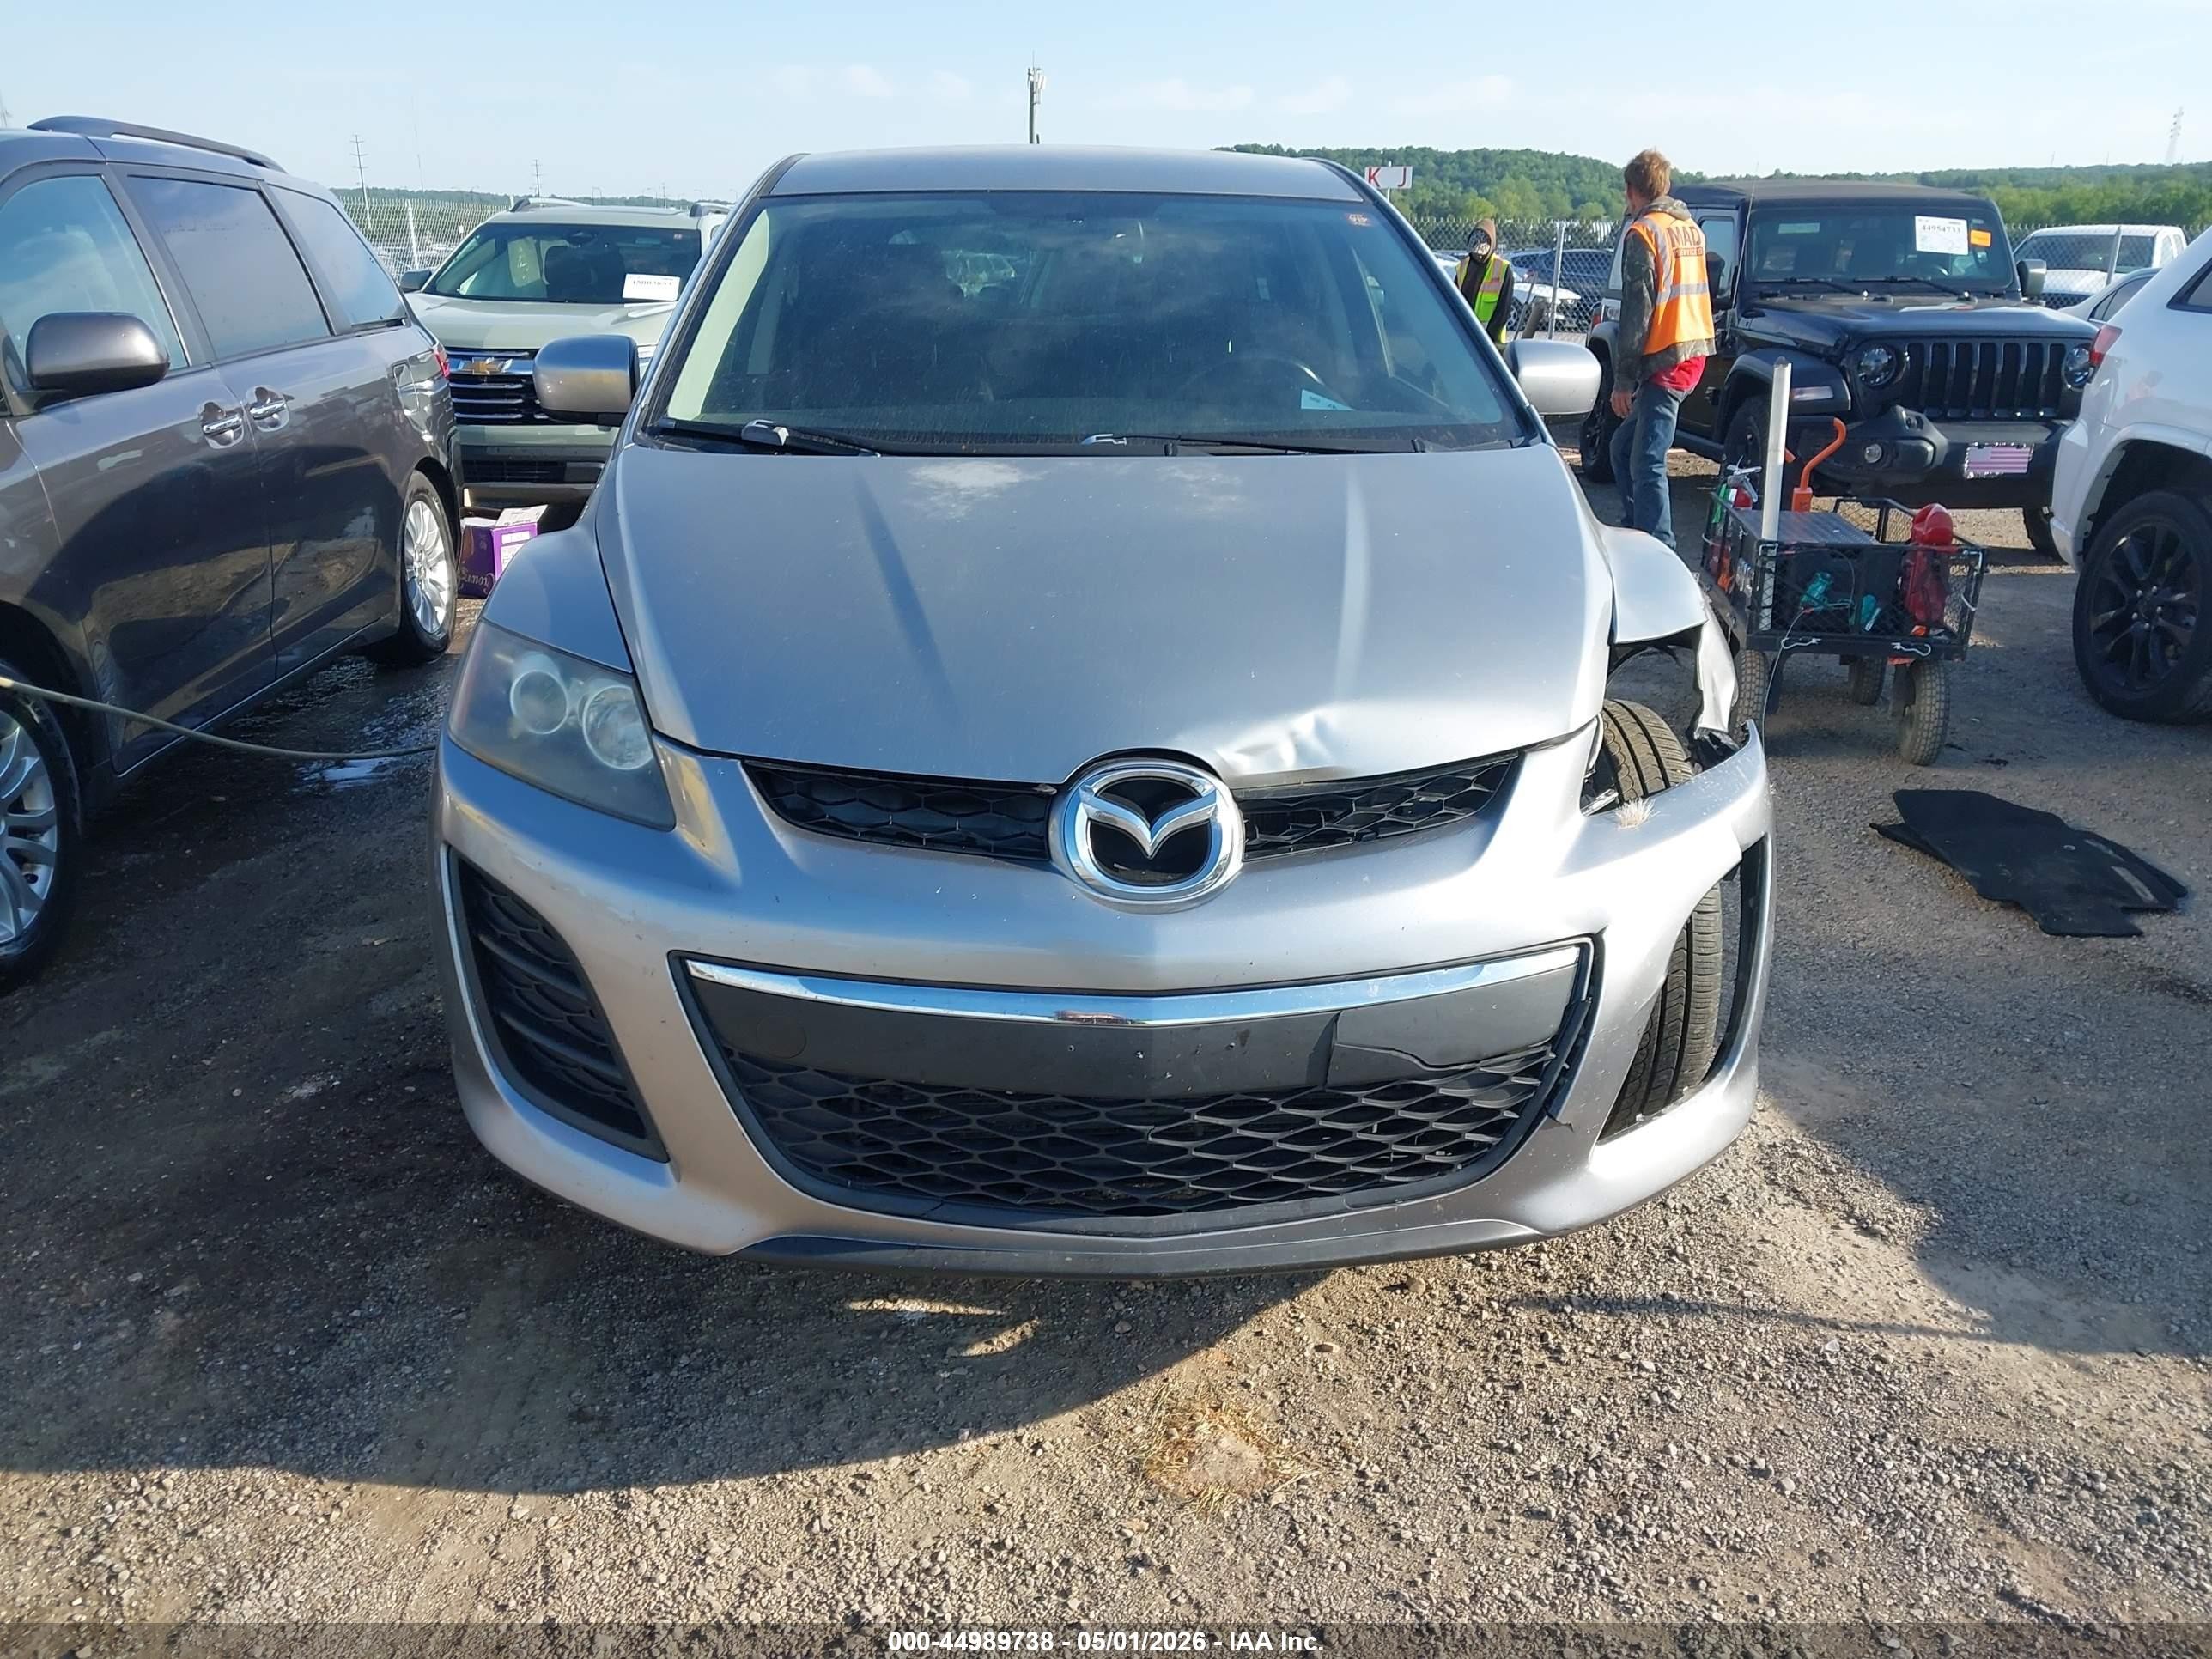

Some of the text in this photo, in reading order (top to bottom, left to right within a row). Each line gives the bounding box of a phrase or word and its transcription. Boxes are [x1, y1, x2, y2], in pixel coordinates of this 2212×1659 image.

[1368, 167, 1407, 187] K J
[1667, 226, 1702, 247] MAD
